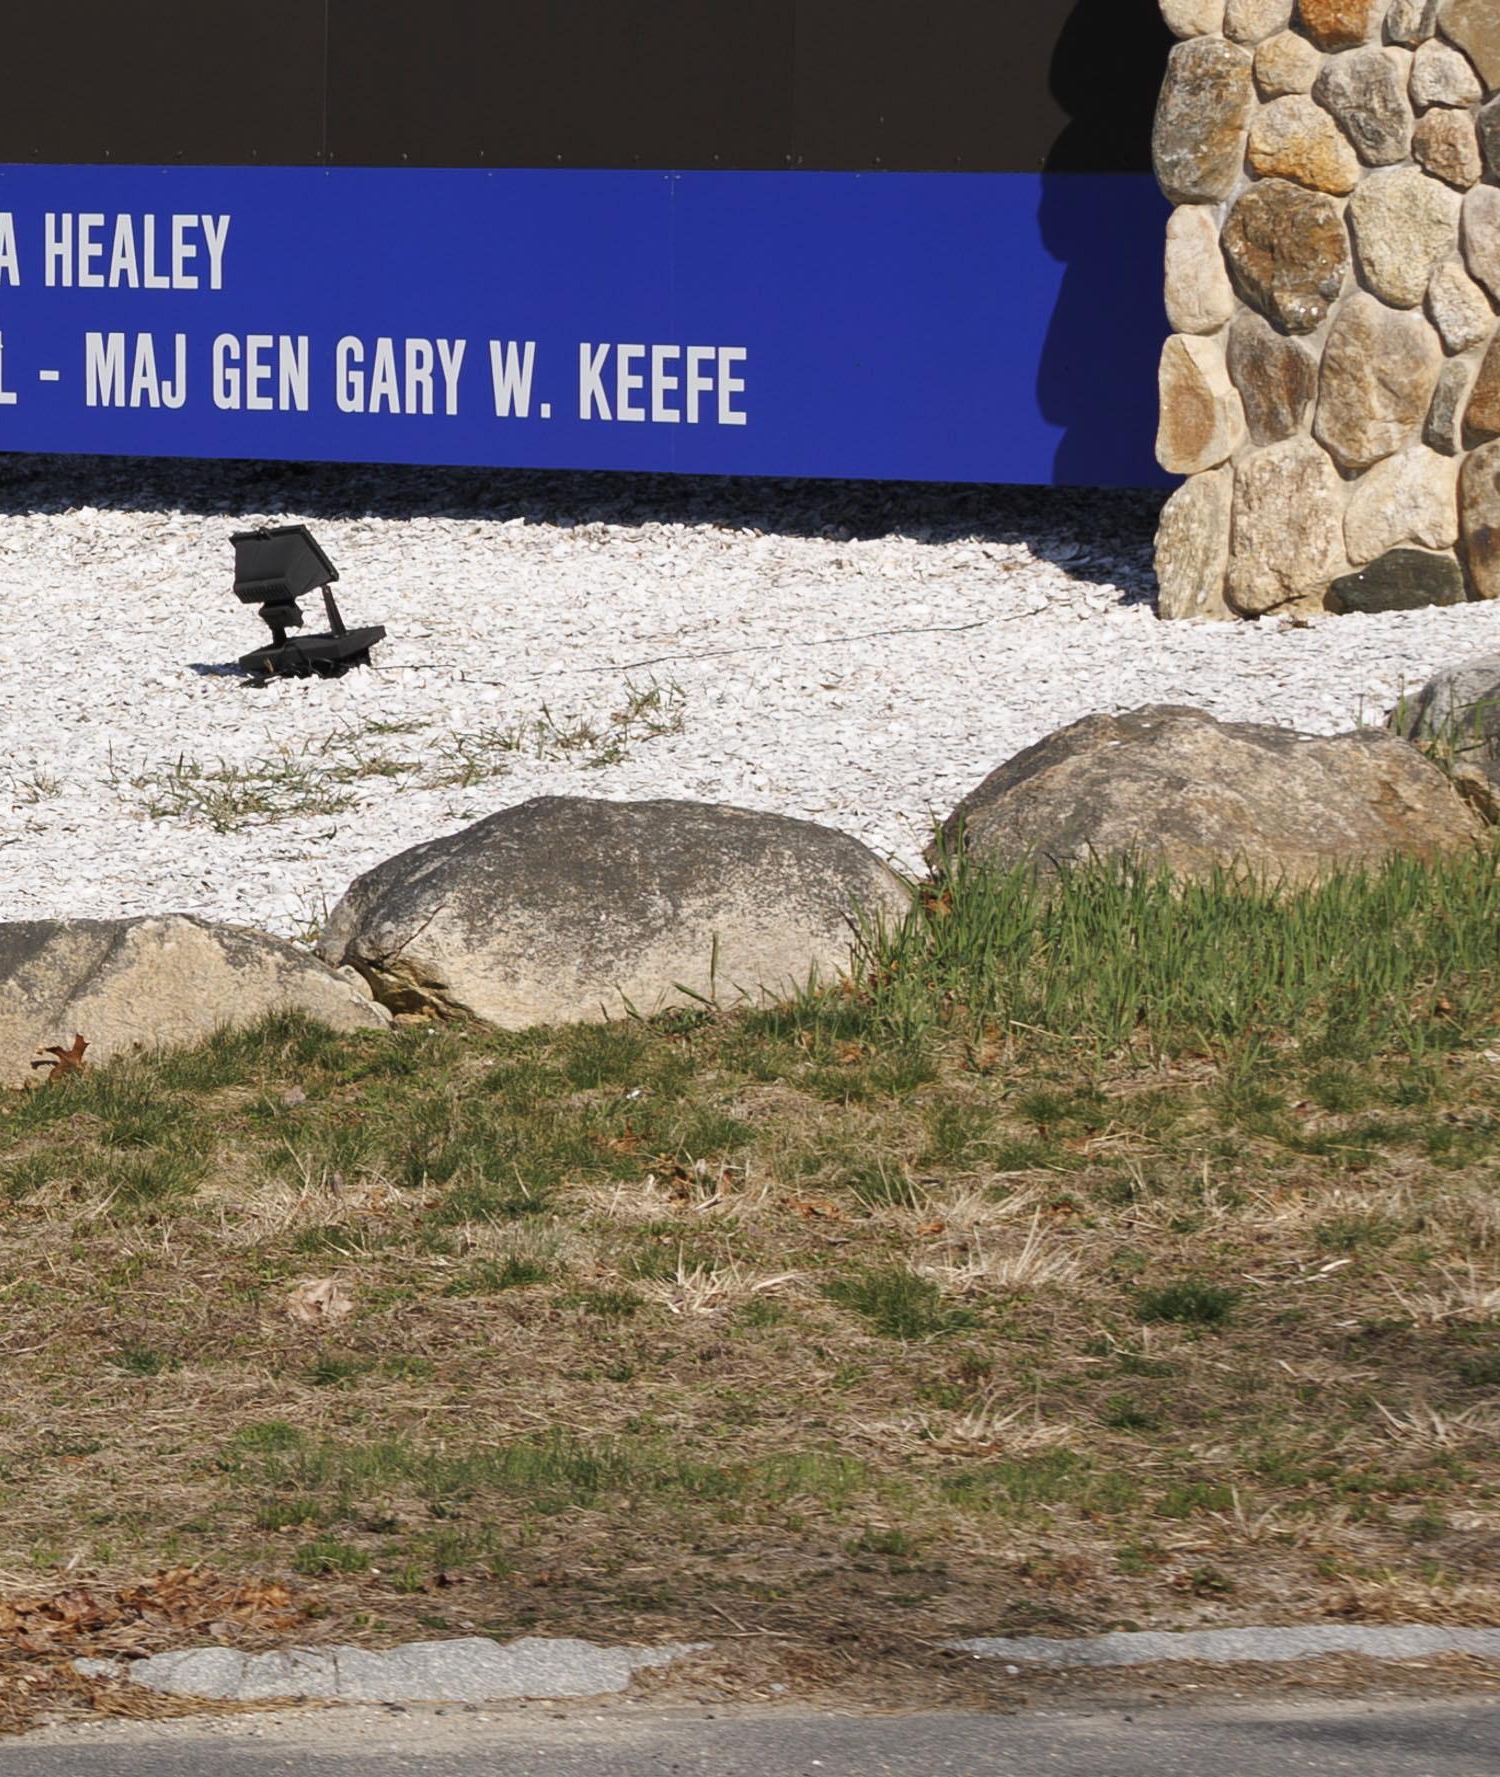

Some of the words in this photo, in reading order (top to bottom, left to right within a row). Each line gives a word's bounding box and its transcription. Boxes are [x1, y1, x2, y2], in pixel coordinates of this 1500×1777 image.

[45, 212, 231, 290] HEALEY
[39, 370, 60, 381] -
[85, 332, 187, 409] MAJ
[212, 333, 309, 411] GEN
[336, 335, 467, 416] GARY
[489, 340, 551, 419] W.
[579, 342, 747, 425] KEEFE
